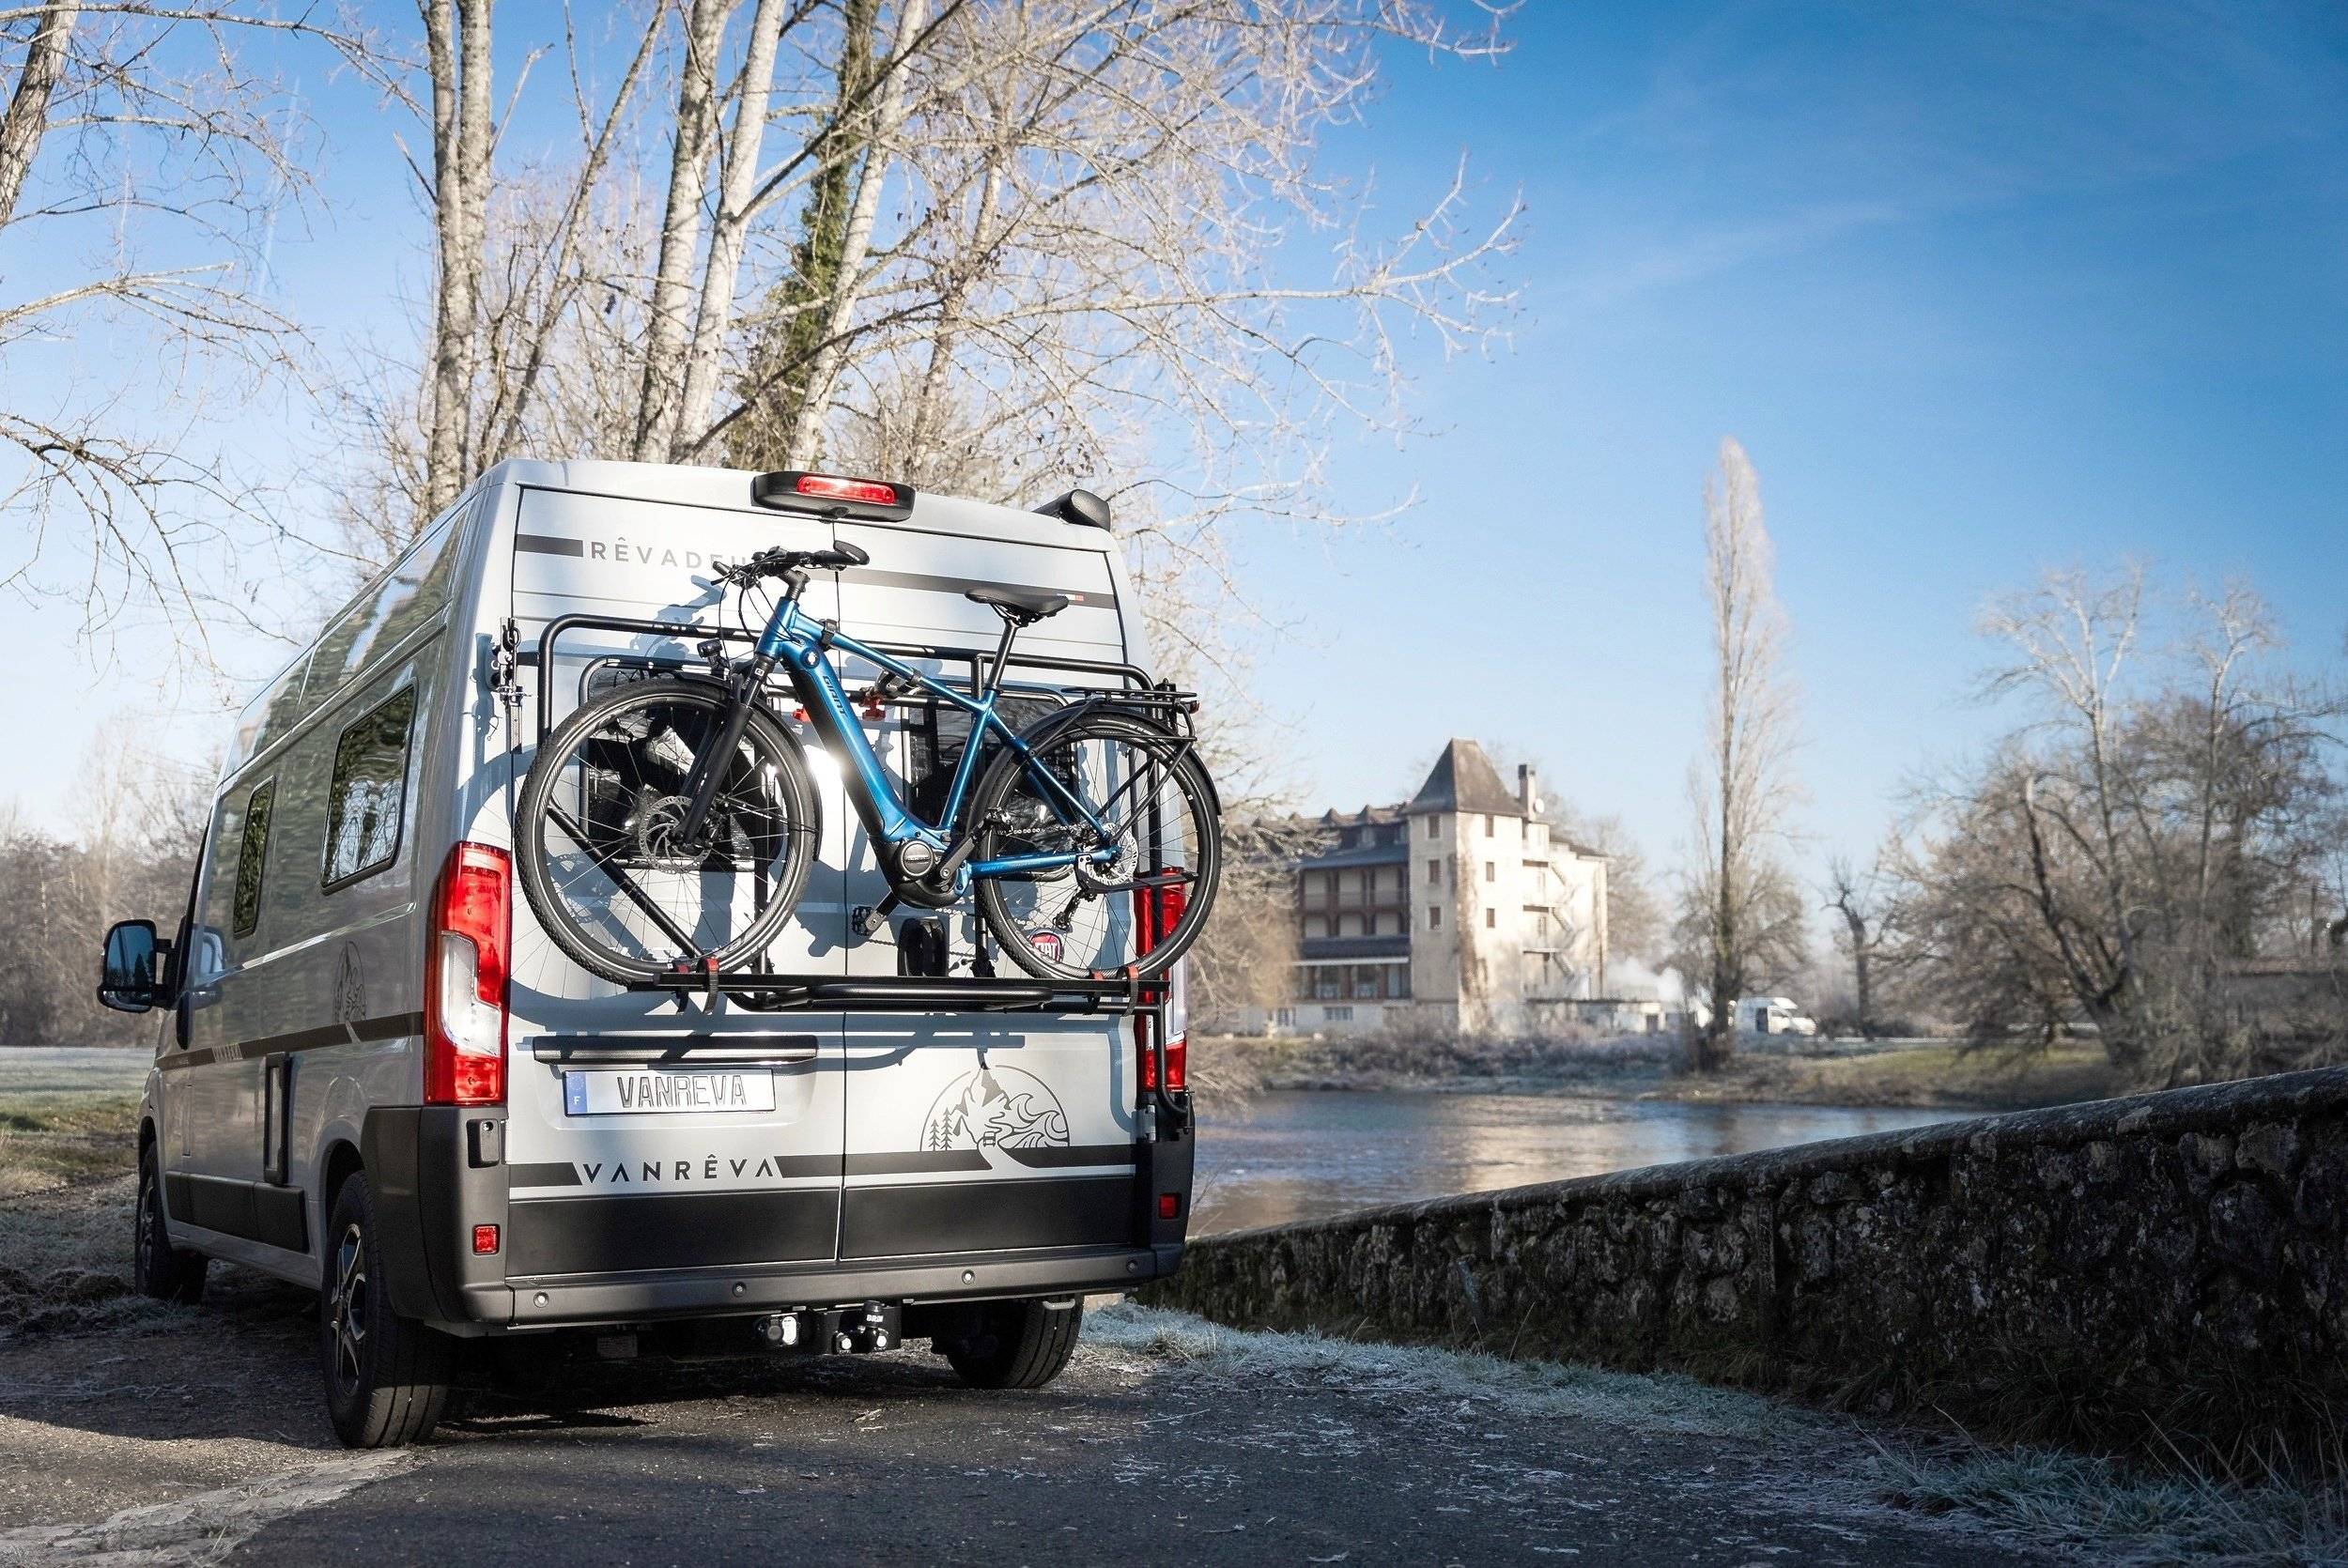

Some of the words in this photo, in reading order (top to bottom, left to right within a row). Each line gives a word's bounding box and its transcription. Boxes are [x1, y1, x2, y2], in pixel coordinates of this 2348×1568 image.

[823, 675, 848, 716] GIANT
[573, 1096, 580, 1105] F
[616, 1074, 748, 1109] VANREVA
[582, 1154, 774, 1184] VANRÊVA
